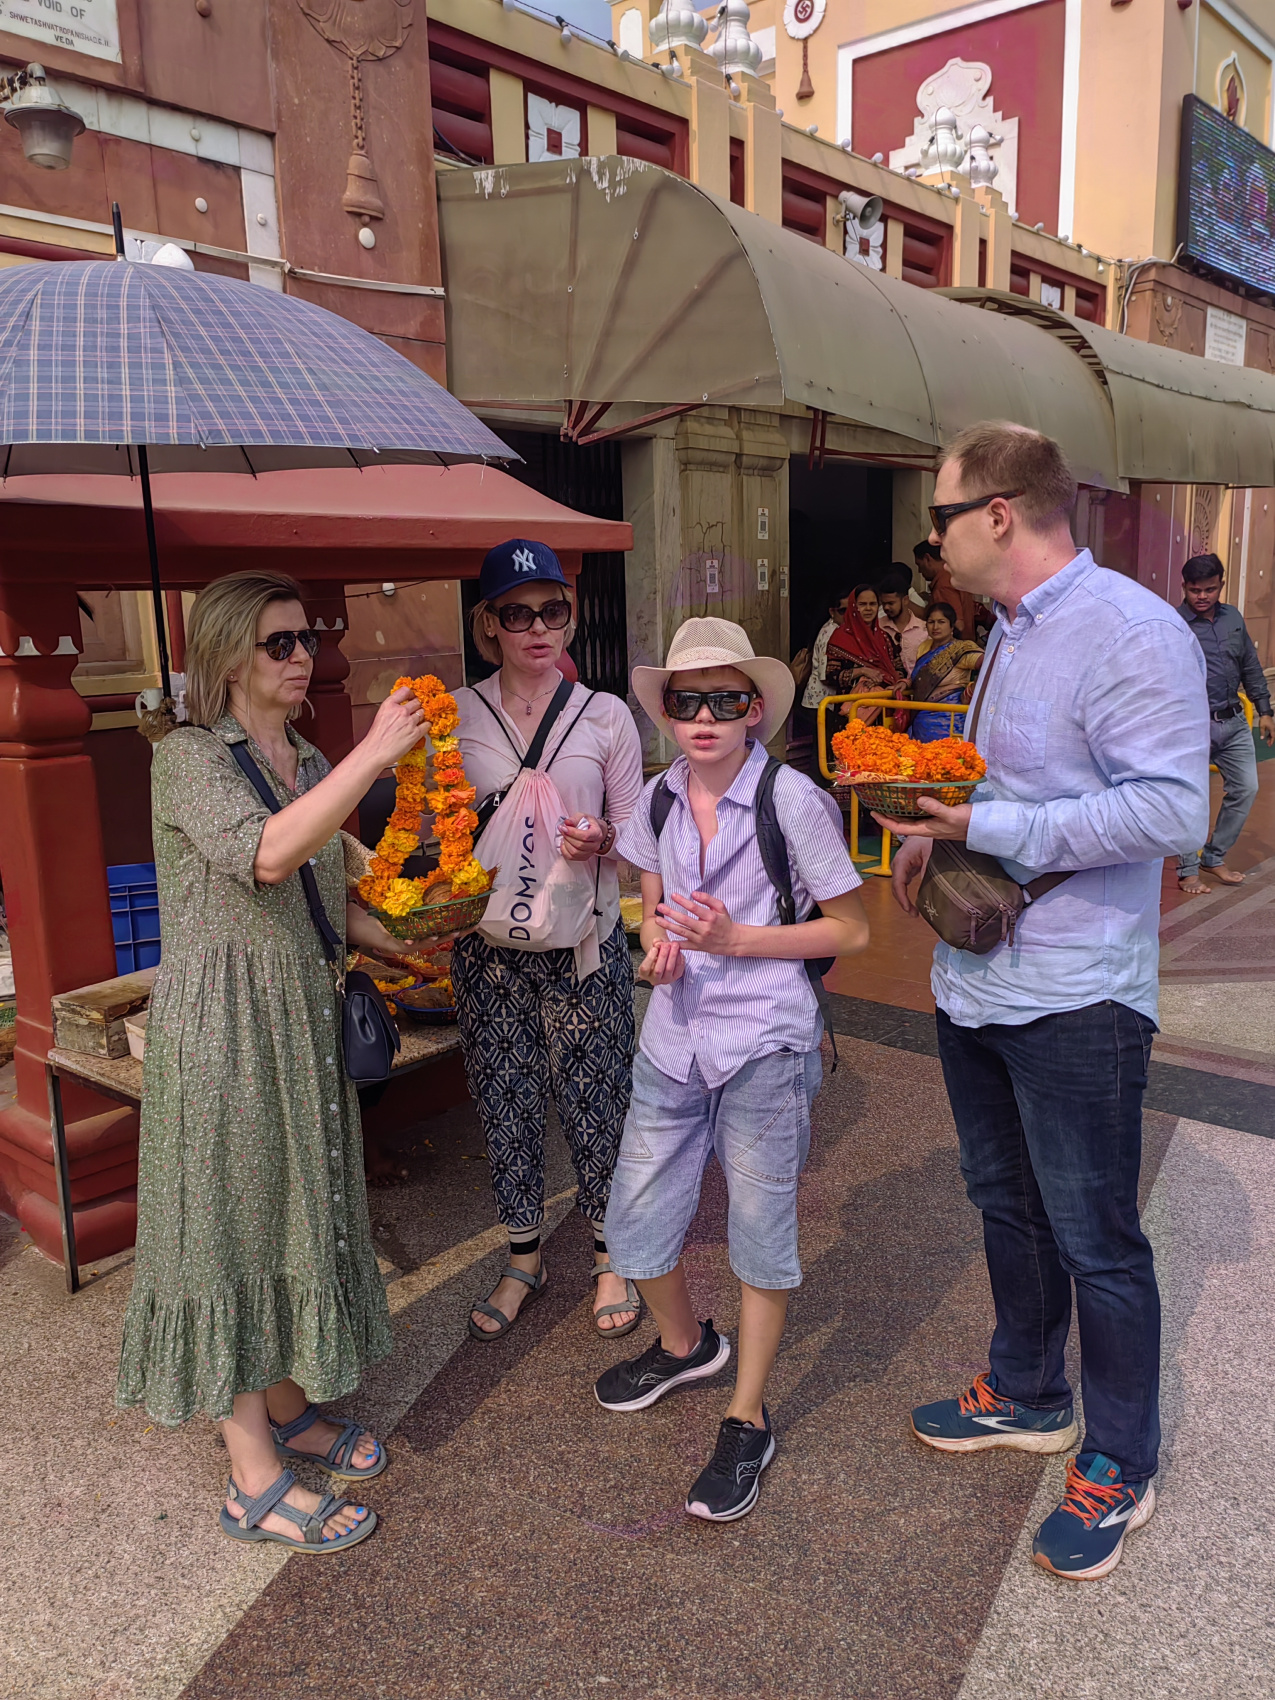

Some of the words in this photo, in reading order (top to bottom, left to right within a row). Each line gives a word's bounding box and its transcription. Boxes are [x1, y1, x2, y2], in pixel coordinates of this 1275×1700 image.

[37, 0, 62, 13] VOID
[70, 6, 86, 19] OF
[54, 34, 75, 47] VEDA
